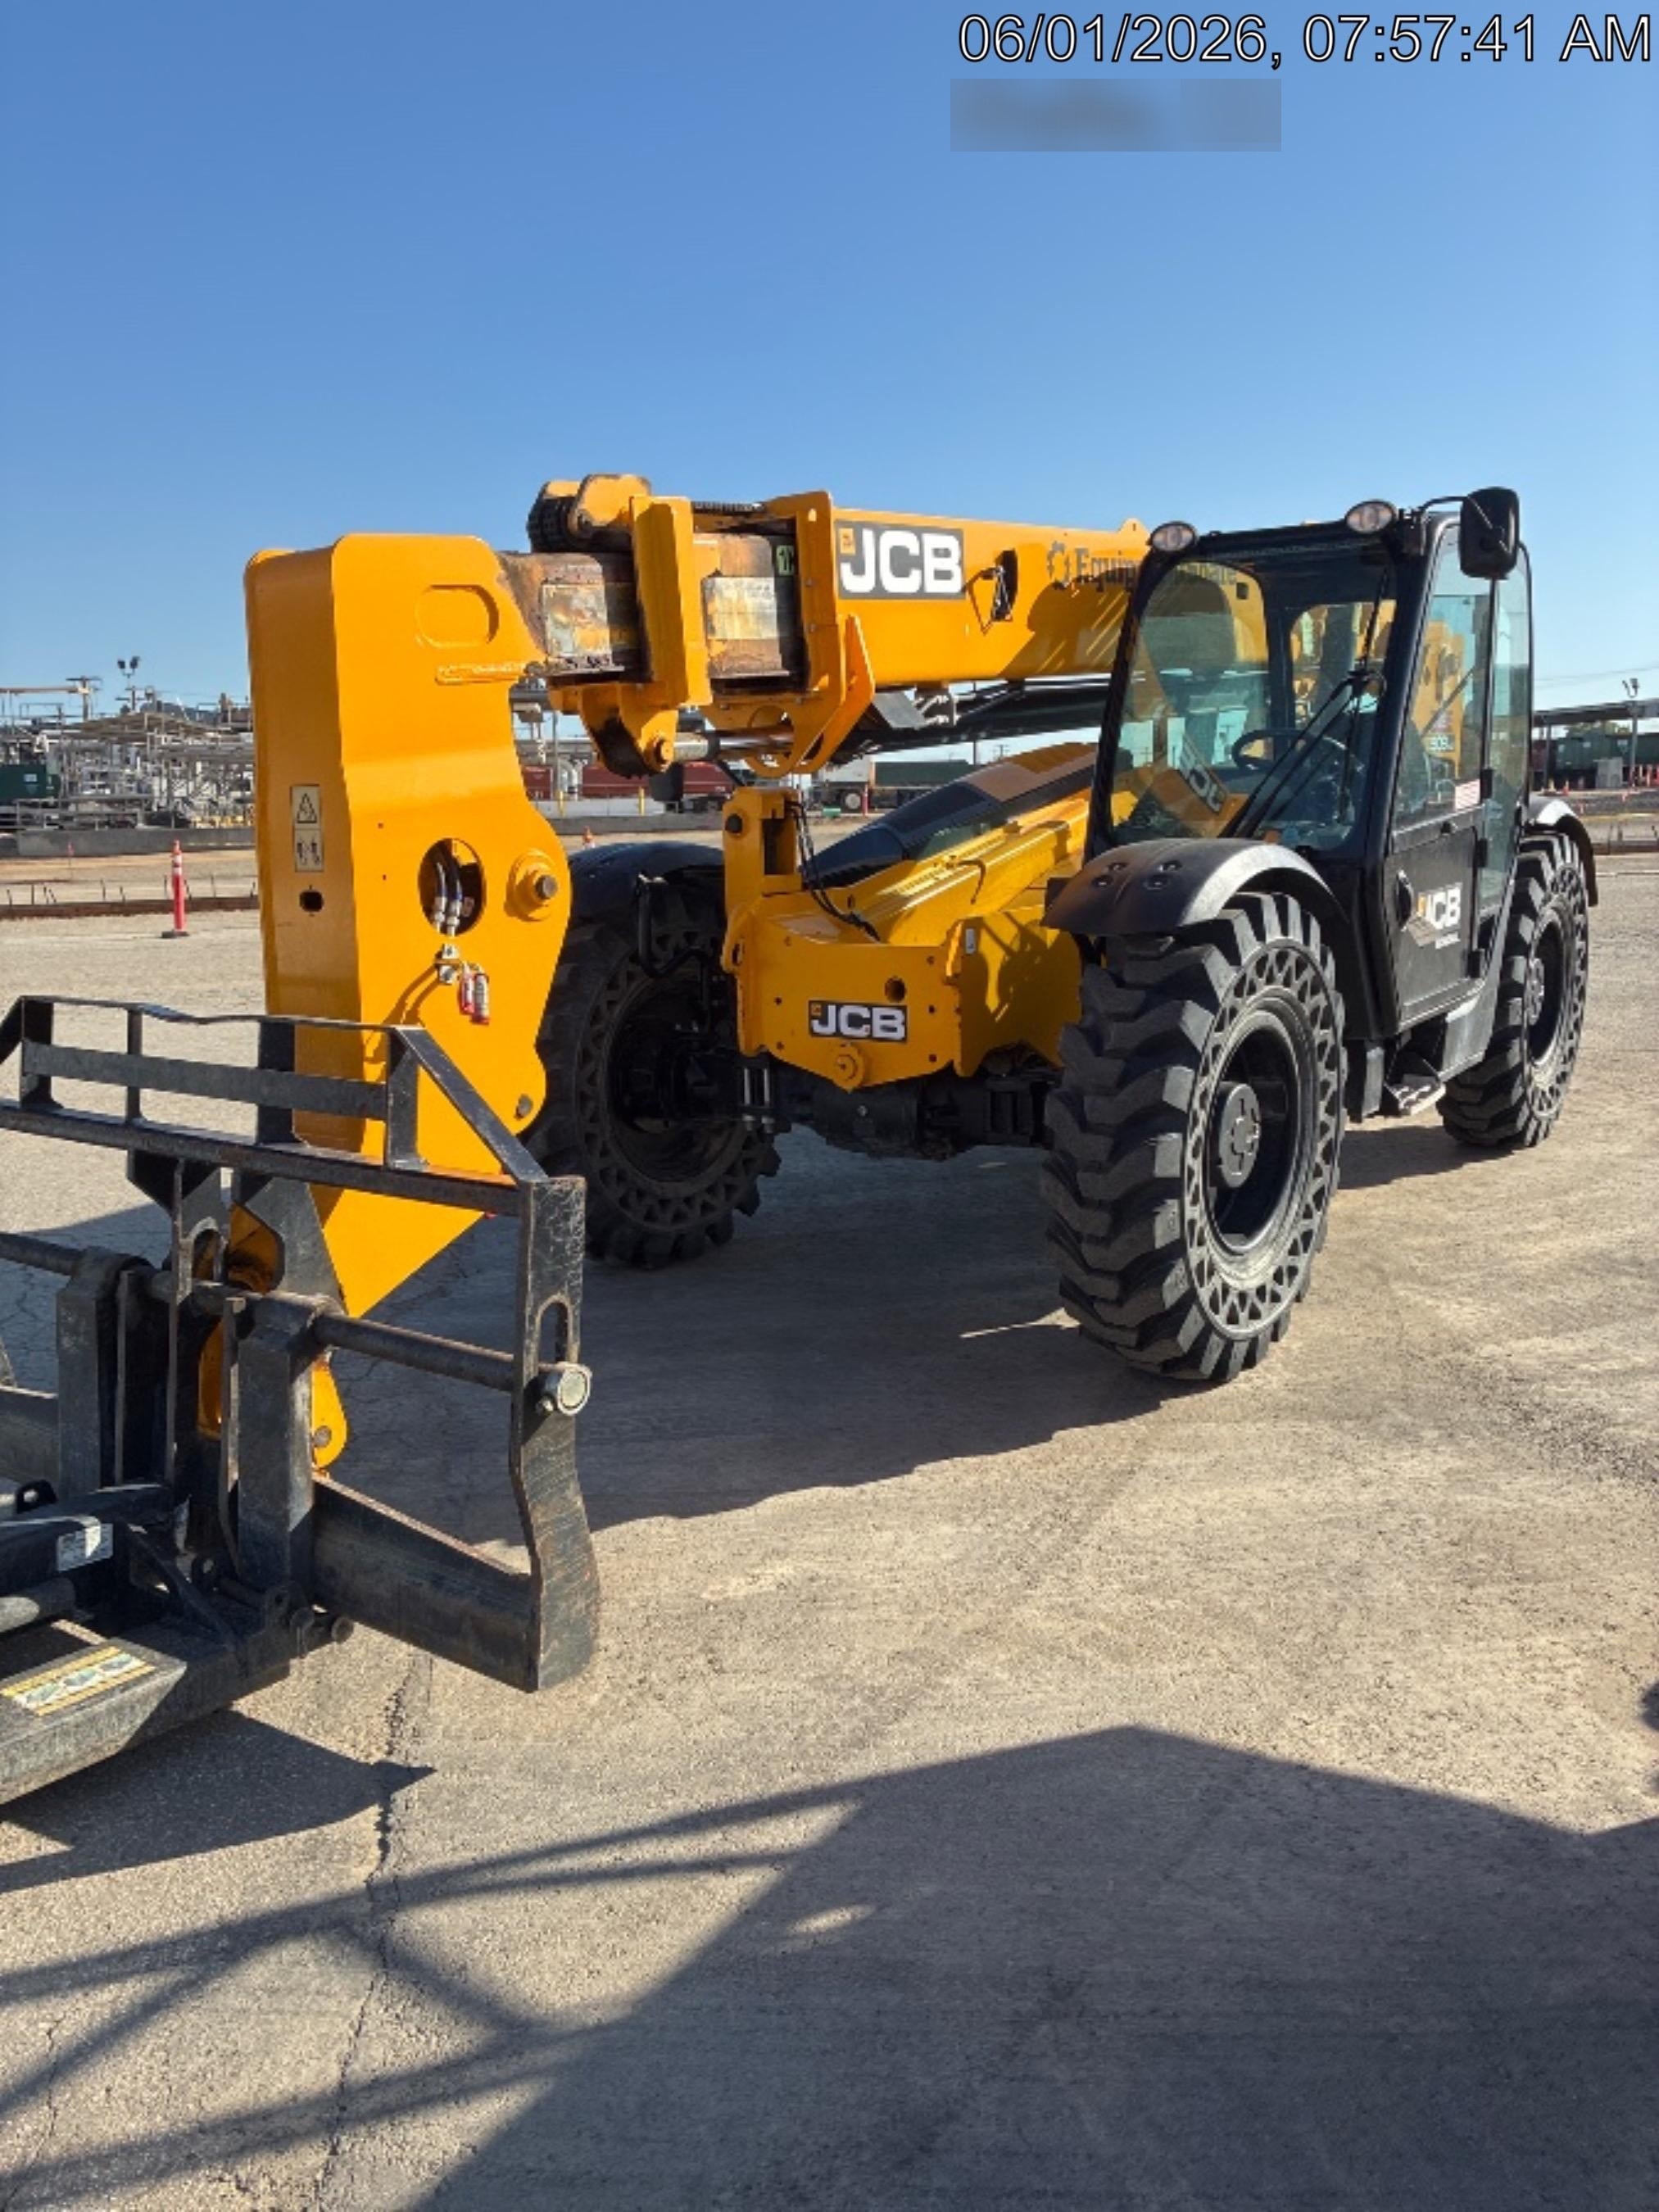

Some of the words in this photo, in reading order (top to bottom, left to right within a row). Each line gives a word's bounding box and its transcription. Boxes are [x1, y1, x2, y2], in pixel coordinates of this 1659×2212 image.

[839, 528, 963, 593] JCB
[1074, 546, 1140, 593] Equip
[1417, 886, 1461, 930] JCB
[810, 1004, 905, 1041] JCB
